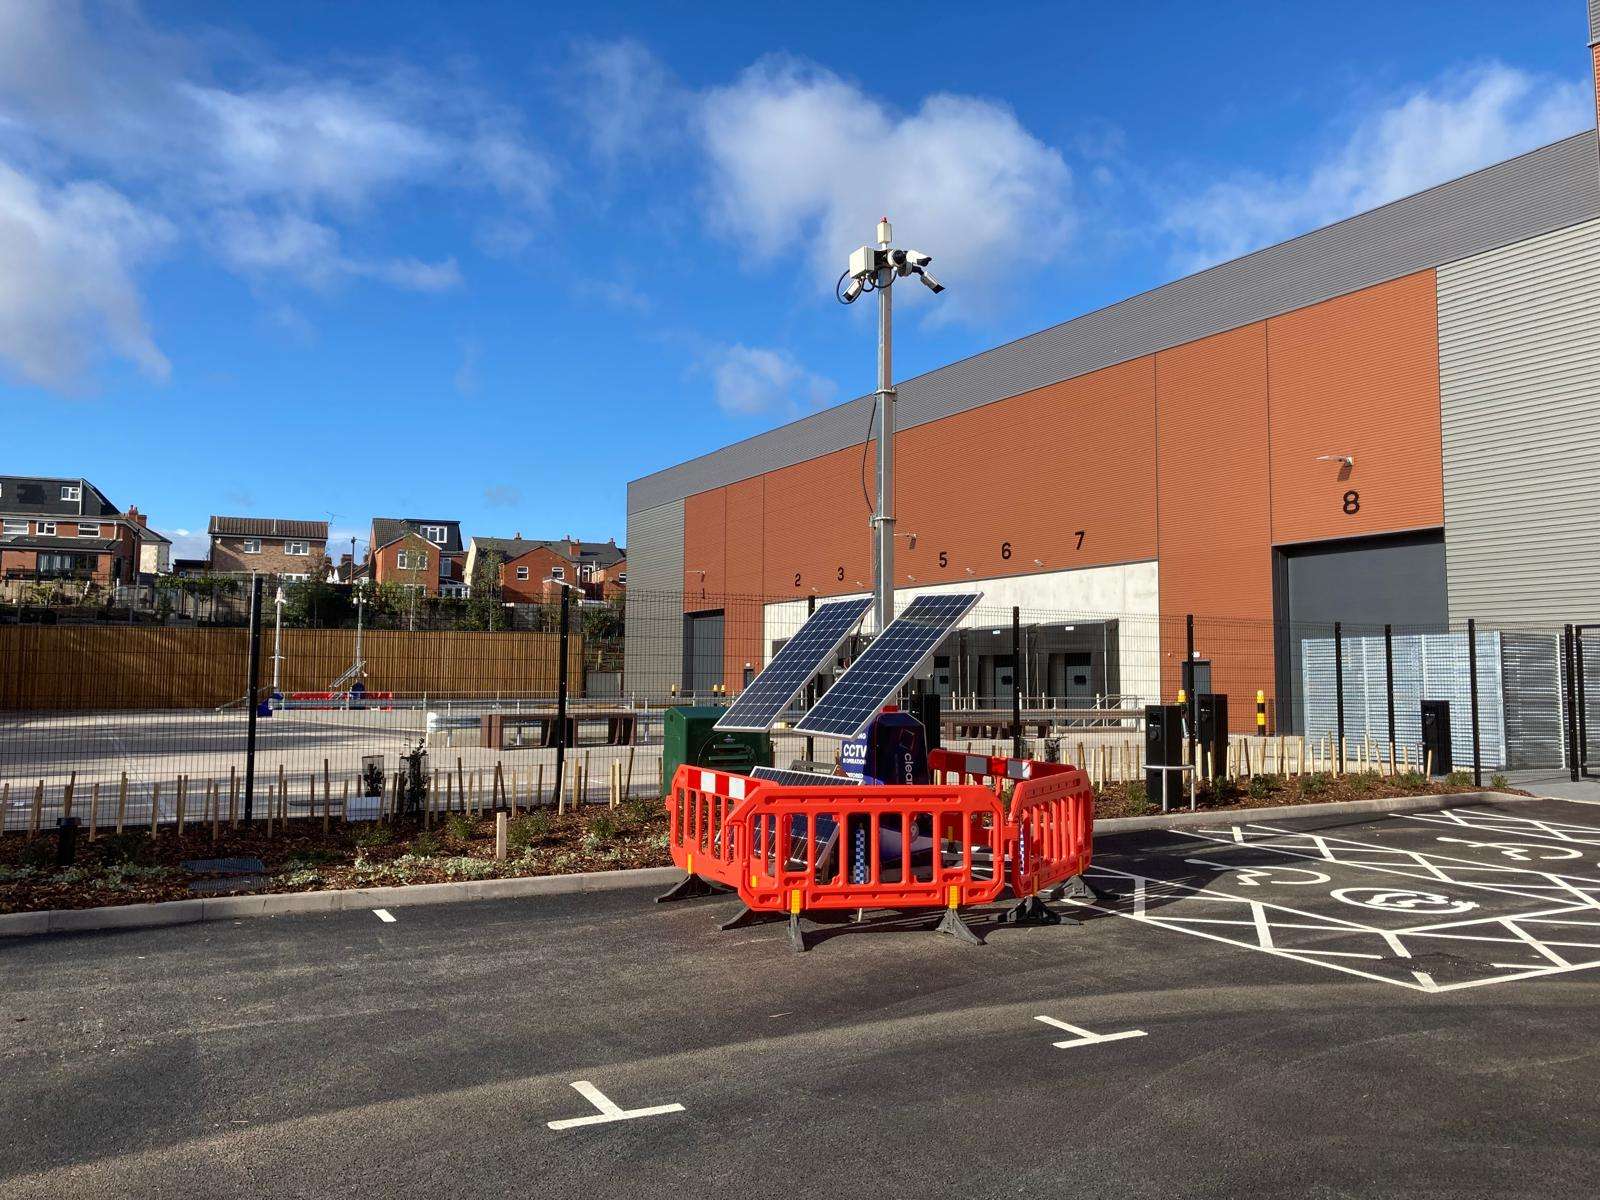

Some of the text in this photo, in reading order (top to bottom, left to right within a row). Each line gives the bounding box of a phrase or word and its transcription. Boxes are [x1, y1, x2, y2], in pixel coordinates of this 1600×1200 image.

[1343, 490, 1360, 515] 8
[1074, 530, 1086, 551] 7
[939, 551, 948, 568] 5
[1001, 542, 1012, 560] 6
[794, 573, 801, 587] 2
[837, 566, 845, 582] 3
[843, 744, 867, 758] CCTV
